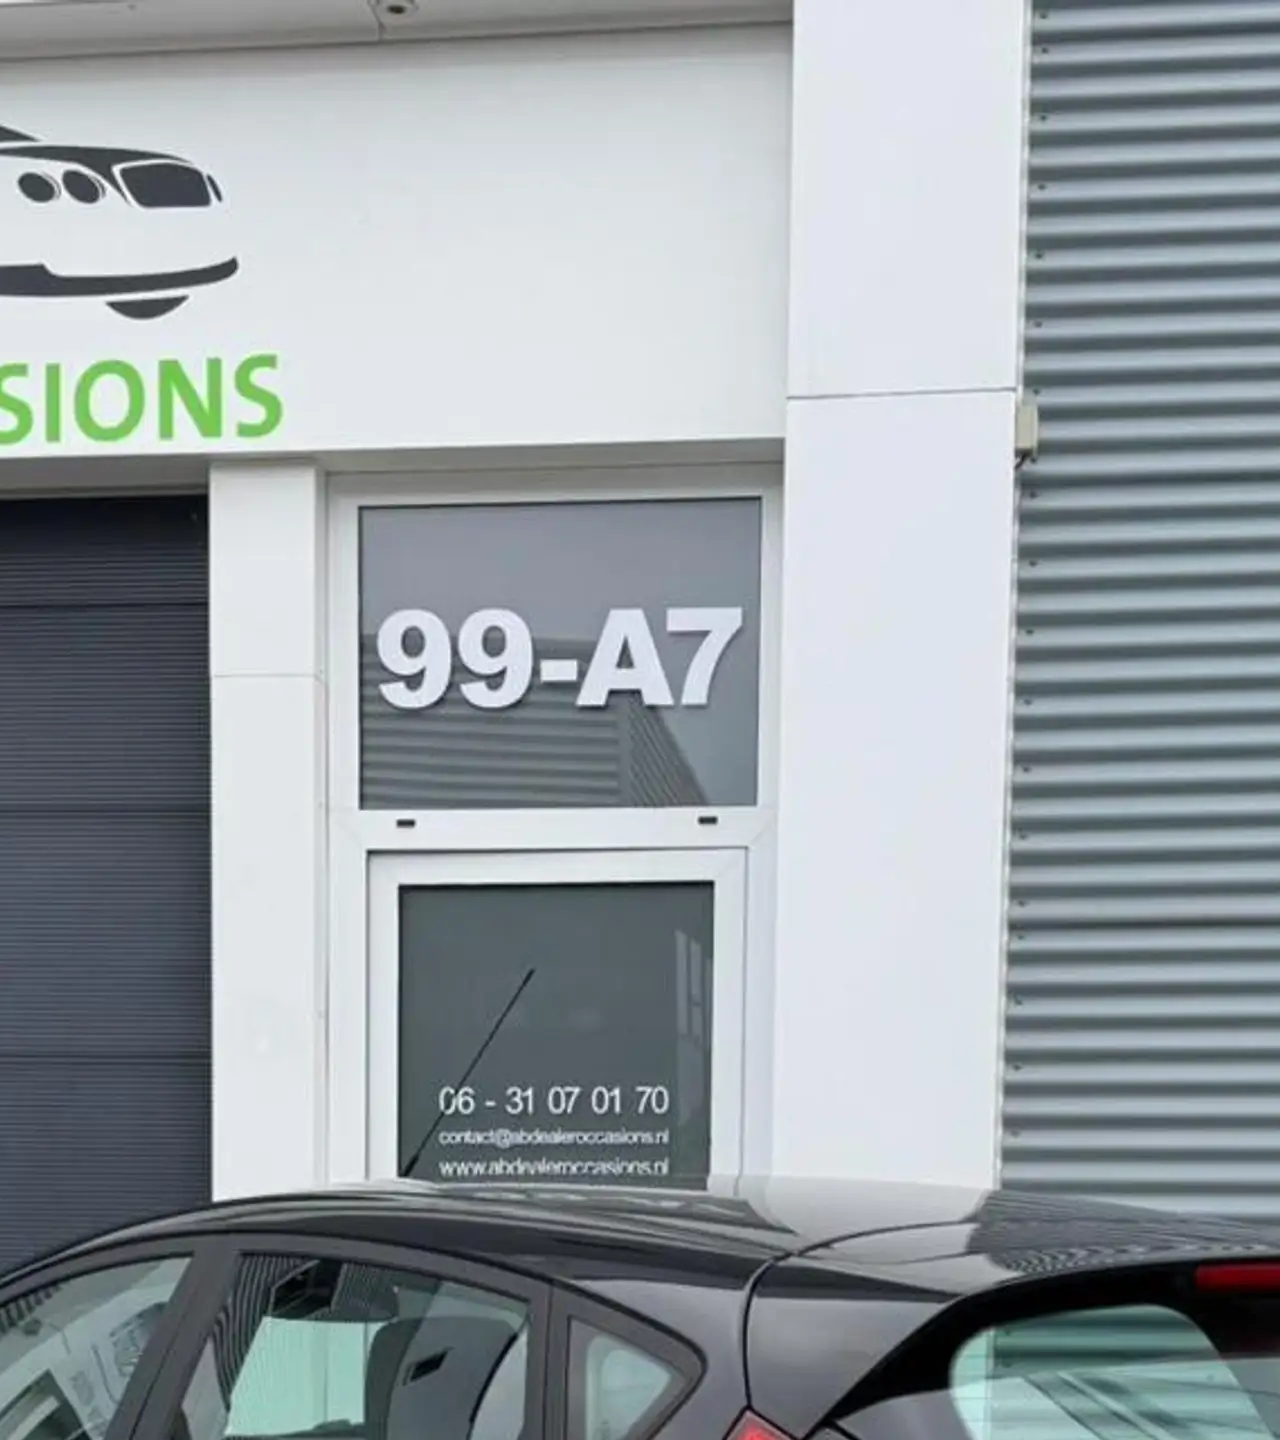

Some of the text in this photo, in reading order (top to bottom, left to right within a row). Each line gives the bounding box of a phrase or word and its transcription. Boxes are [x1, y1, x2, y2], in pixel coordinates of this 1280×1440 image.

[375, 606, 744, 709] 99-A7
[438, 1085, 476, 1115] 06
[505, 1086, 534, 1115] 31
[547, 1086, 582, 1115] 07
[591, 1086, 621, 1115] 01
[634, 1085, 669, 1115] 70
